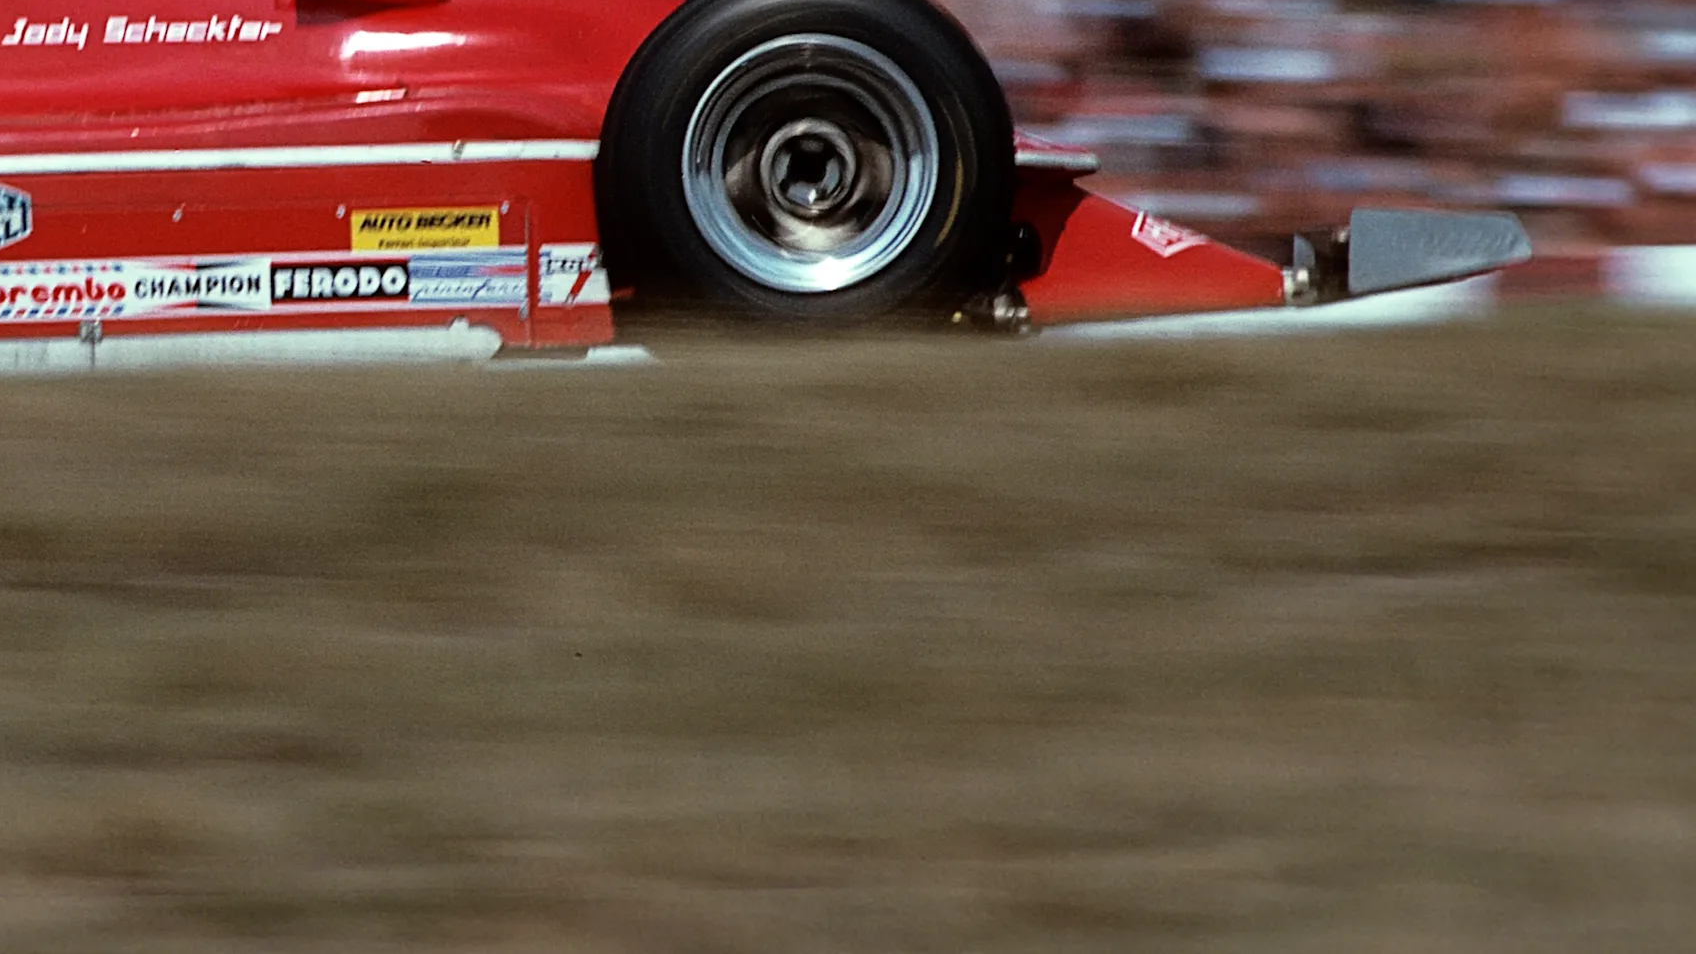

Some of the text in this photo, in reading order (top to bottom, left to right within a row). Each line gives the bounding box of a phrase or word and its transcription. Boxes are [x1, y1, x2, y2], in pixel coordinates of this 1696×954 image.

[1, 16, 89, 51] Jody
[134, 273, 262, 299] CHAMPION
[273, 265, 408, 300] FERODO
